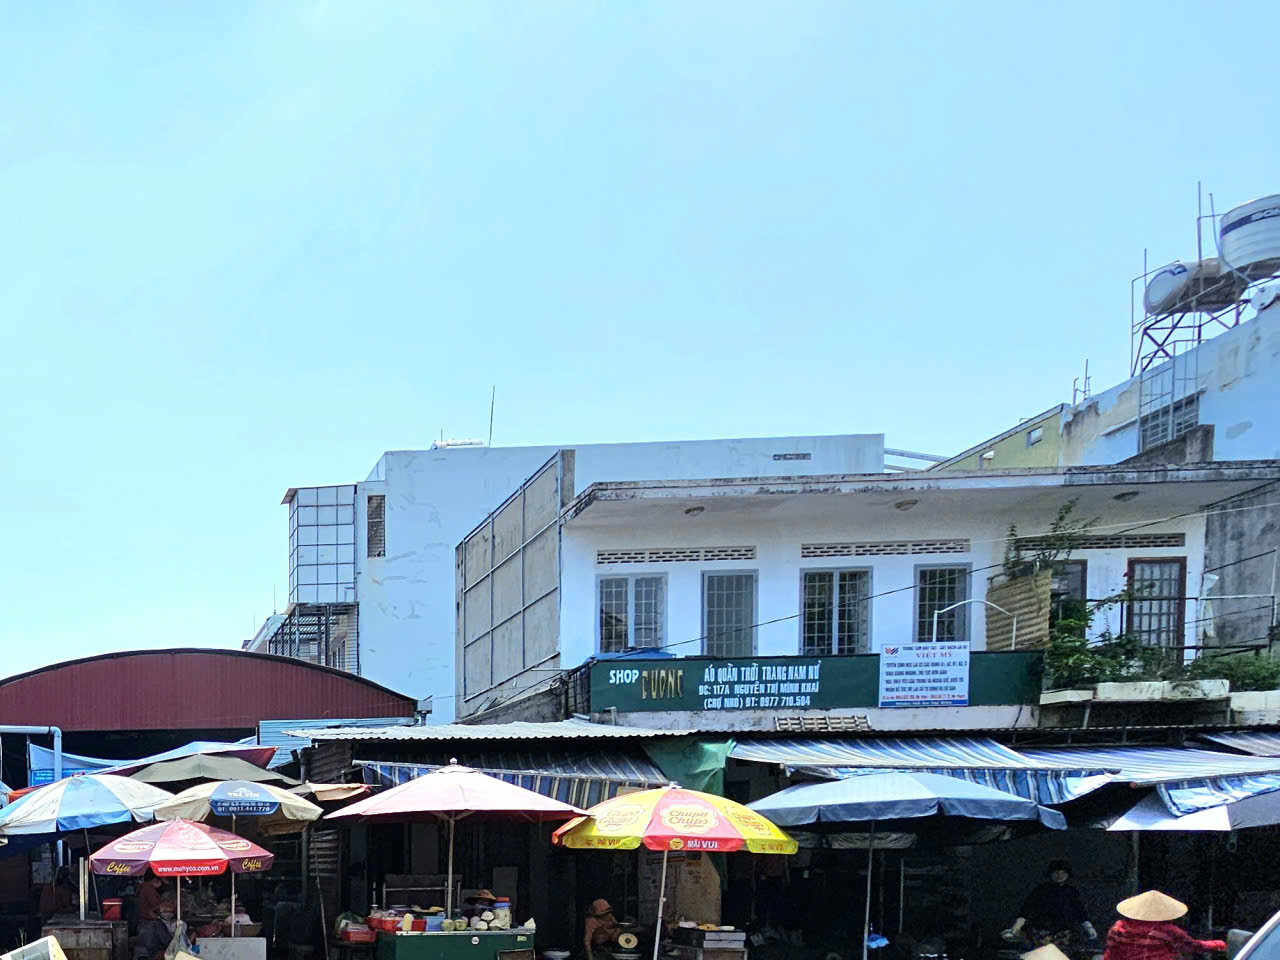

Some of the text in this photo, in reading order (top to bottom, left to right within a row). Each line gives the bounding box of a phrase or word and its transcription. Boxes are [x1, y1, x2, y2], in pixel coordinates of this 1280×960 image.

[609, 669, 640, 685] SHOP
[762, 666, 787, 681] TRANG
[787, 665, 806, 680] NAM
[713, 684, 731, 696] 117A
[760, 696, 778, 707] 0977
[668, 815, 709, 826] Chups
[669, 810, 708, 819] Chupa
[702, 840, 718, 849] VUI
[106, 862, 131, 874] Coffee
[242, 858, 262, 870] Coffee
